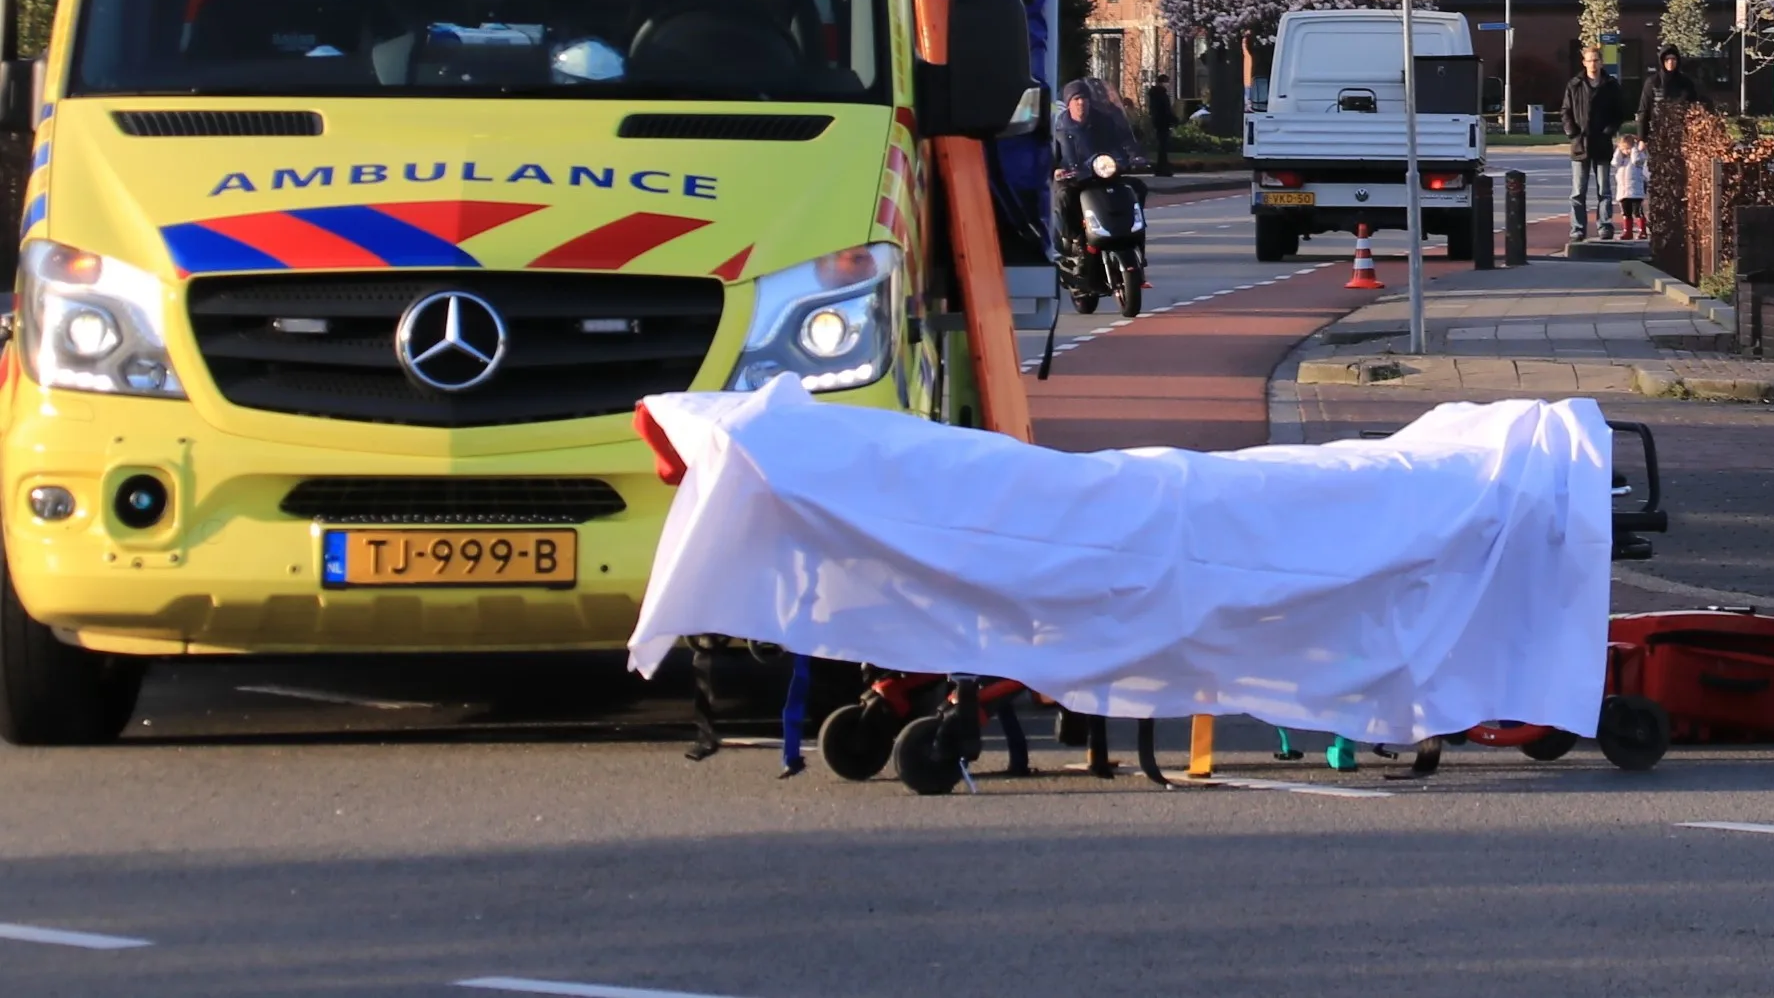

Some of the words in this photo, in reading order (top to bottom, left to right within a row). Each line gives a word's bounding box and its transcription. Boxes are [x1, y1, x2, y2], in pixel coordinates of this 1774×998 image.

[206, 161, 718, 200] AMBULANCE
[326, 562, 343, 574] NL
[364, 539, 557, 575] TJ-999-B
